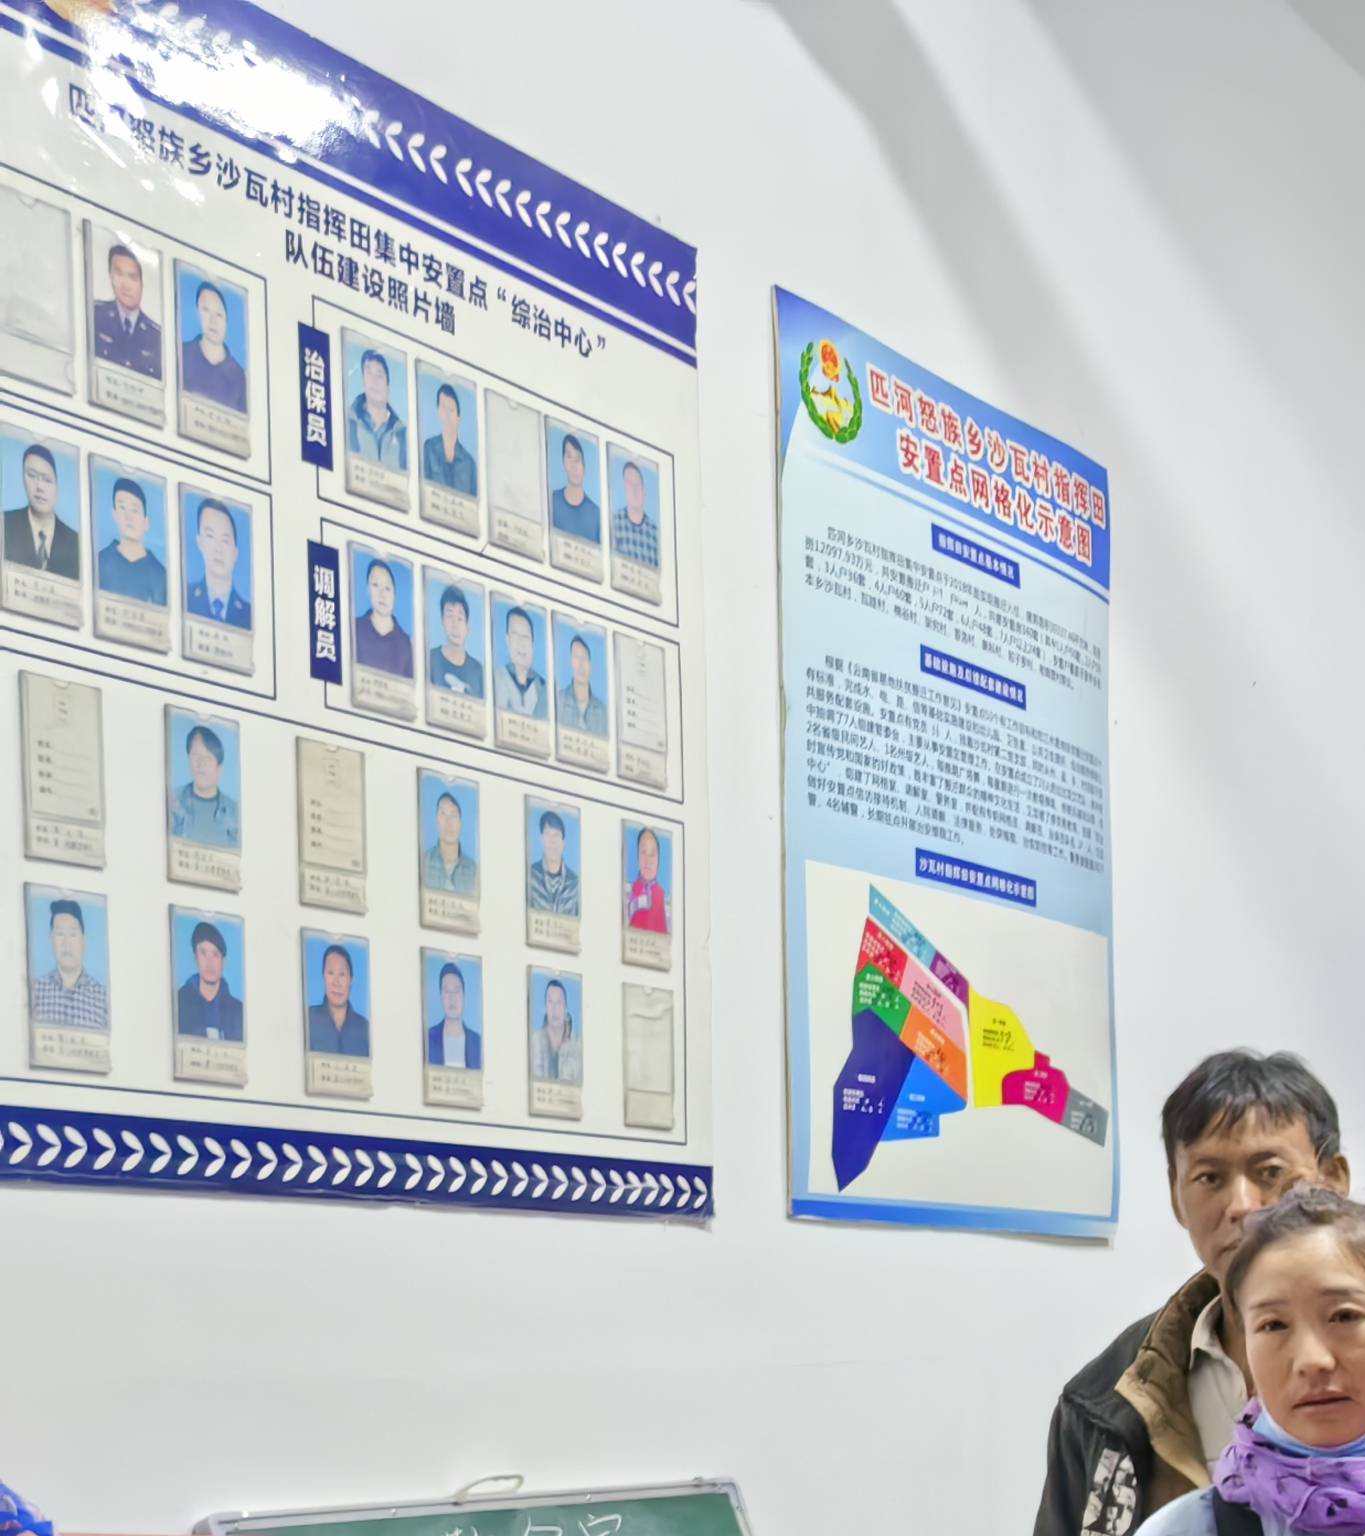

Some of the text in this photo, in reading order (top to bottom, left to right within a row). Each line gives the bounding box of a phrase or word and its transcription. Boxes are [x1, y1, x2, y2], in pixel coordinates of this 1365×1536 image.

[285, 228, 456, 336] 队伍建设照片墙
[304, 347, 328, 447] 治保员
[867, 364, 1105, 525] 匹河怒族乡沙瓦村指挥田
[899, 431, 1091, 558] 安置点网格化示意图
[313, 564, 337, 663] 调解员
